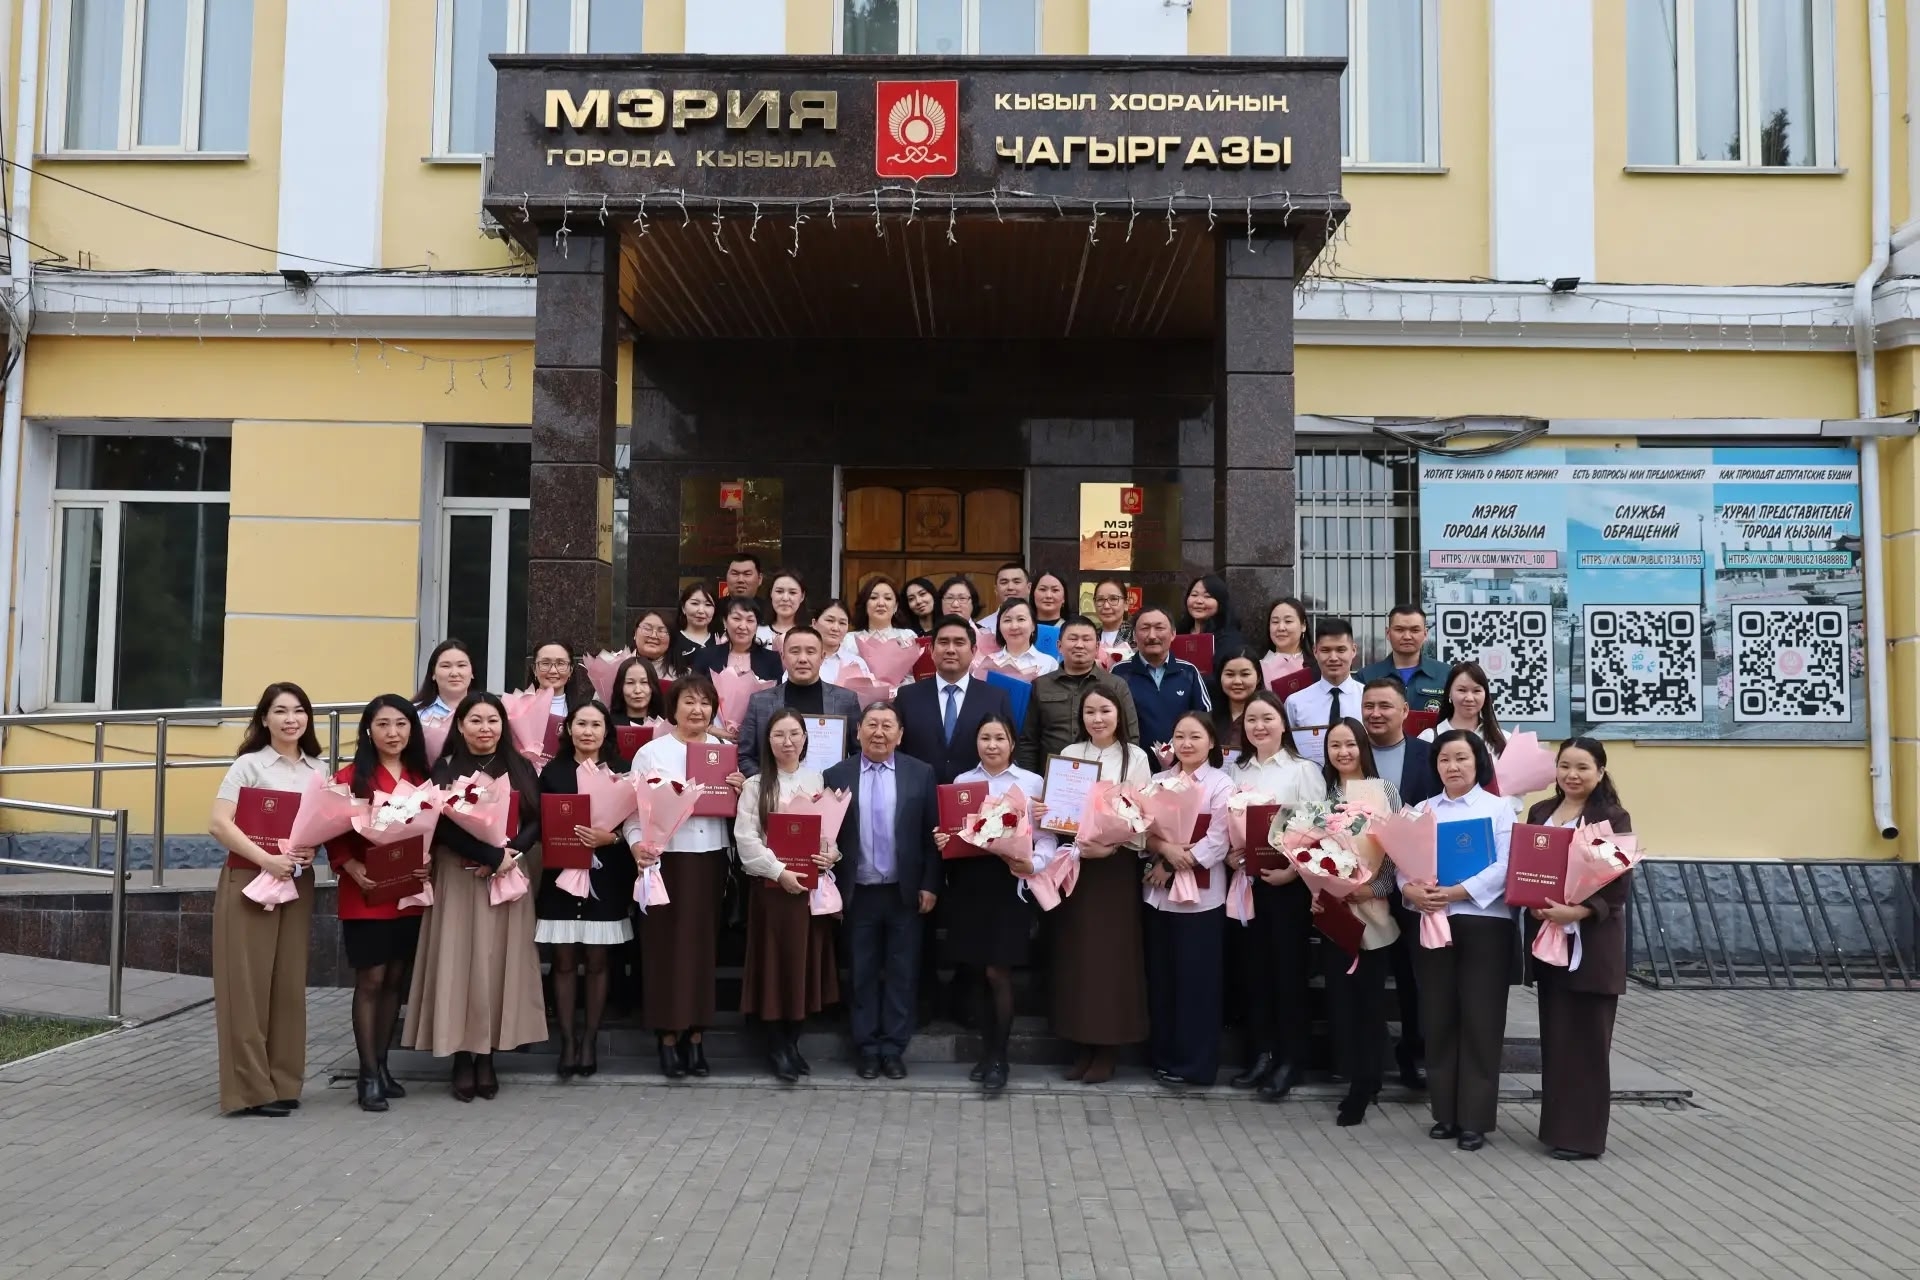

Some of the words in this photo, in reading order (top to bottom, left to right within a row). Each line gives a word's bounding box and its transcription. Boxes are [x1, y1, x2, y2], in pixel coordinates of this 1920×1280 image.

[544, 89, 838, 130] МЭРИЯ
[994, 93, 1096, 111] КЫЗЫЛ
[995, 135, 1292, 165] ЧАГЫРГАЗЫ
[546, 149, 676, 168] ГОРОДА
[696, 150, 836, 168] КЫЗЫЛА
[1424, 469, 1454, 479] ХОТИТЕ
[1455, 469, 1485, 479] УЗНАТЬ
[1487, 469, 1493, 479] О
[1494, 469, 1523, 479] РАБОТЕ
[1525, 469, 1559, 479] МЭРИИ?
[1572, 469, 1590, 479] ЕСТЬ
[1592, 469, 1627, 479] ВОПРОСЫ
[1629, 469, 1644, 479] ИЛИ
[1645, 469, 1706, 479] ПРЕДЛОЖЕНИЯ?
[1719, 469, 1735, 479] КАК
[1736, 469, 1775, 479] ПРОХОДЯТ
[1775, 469, 1825, 480] ДЕПУТАТСКИЕ
[1827, 469, 1852, 479] БУДНИ
[1472, 504, 1518, 519] МЭРИЯ
[1615, 504, 1666, 519] СЛУЖБА
[1722, 504, 1756, 519] ХУРАЛ
[1758, 503, 1853, 519] ПРЕДСТАВИТЕЛЕЙ
[1443, 524, 1488, 538] ГОРОДА
[1491, 524, 1546, 539] КЫЗЫЛА
[1603, 522, 1680, 541] ОБРАЩЕНИЙ
[1742, 524, 1782, 538] ГОРОДА
[1784, 524, 1832, 539] КЫЗЫЛА
[1441, 554, 1545, 565] HTTPS://VK.COM/MKYZYL_100
